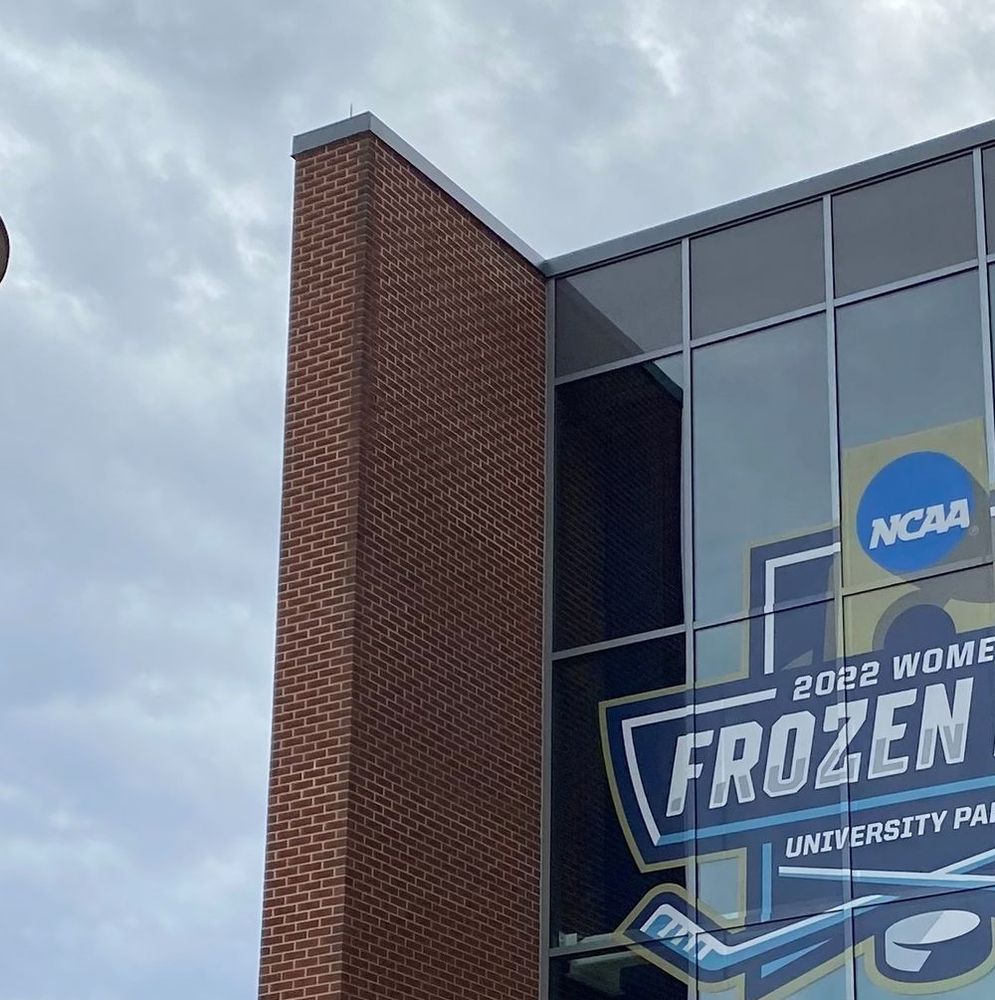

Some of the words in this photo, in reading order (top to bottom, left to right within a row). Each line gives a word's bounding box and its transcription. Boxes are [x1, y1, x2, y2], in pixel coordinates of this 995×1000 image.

[869, 498, 970, 550] NCAA
[793, 662, 879, 699] 2022
[665, 676, 975, 818] FROZEN
[785, 810, 947, 858] UNIVERSITY
